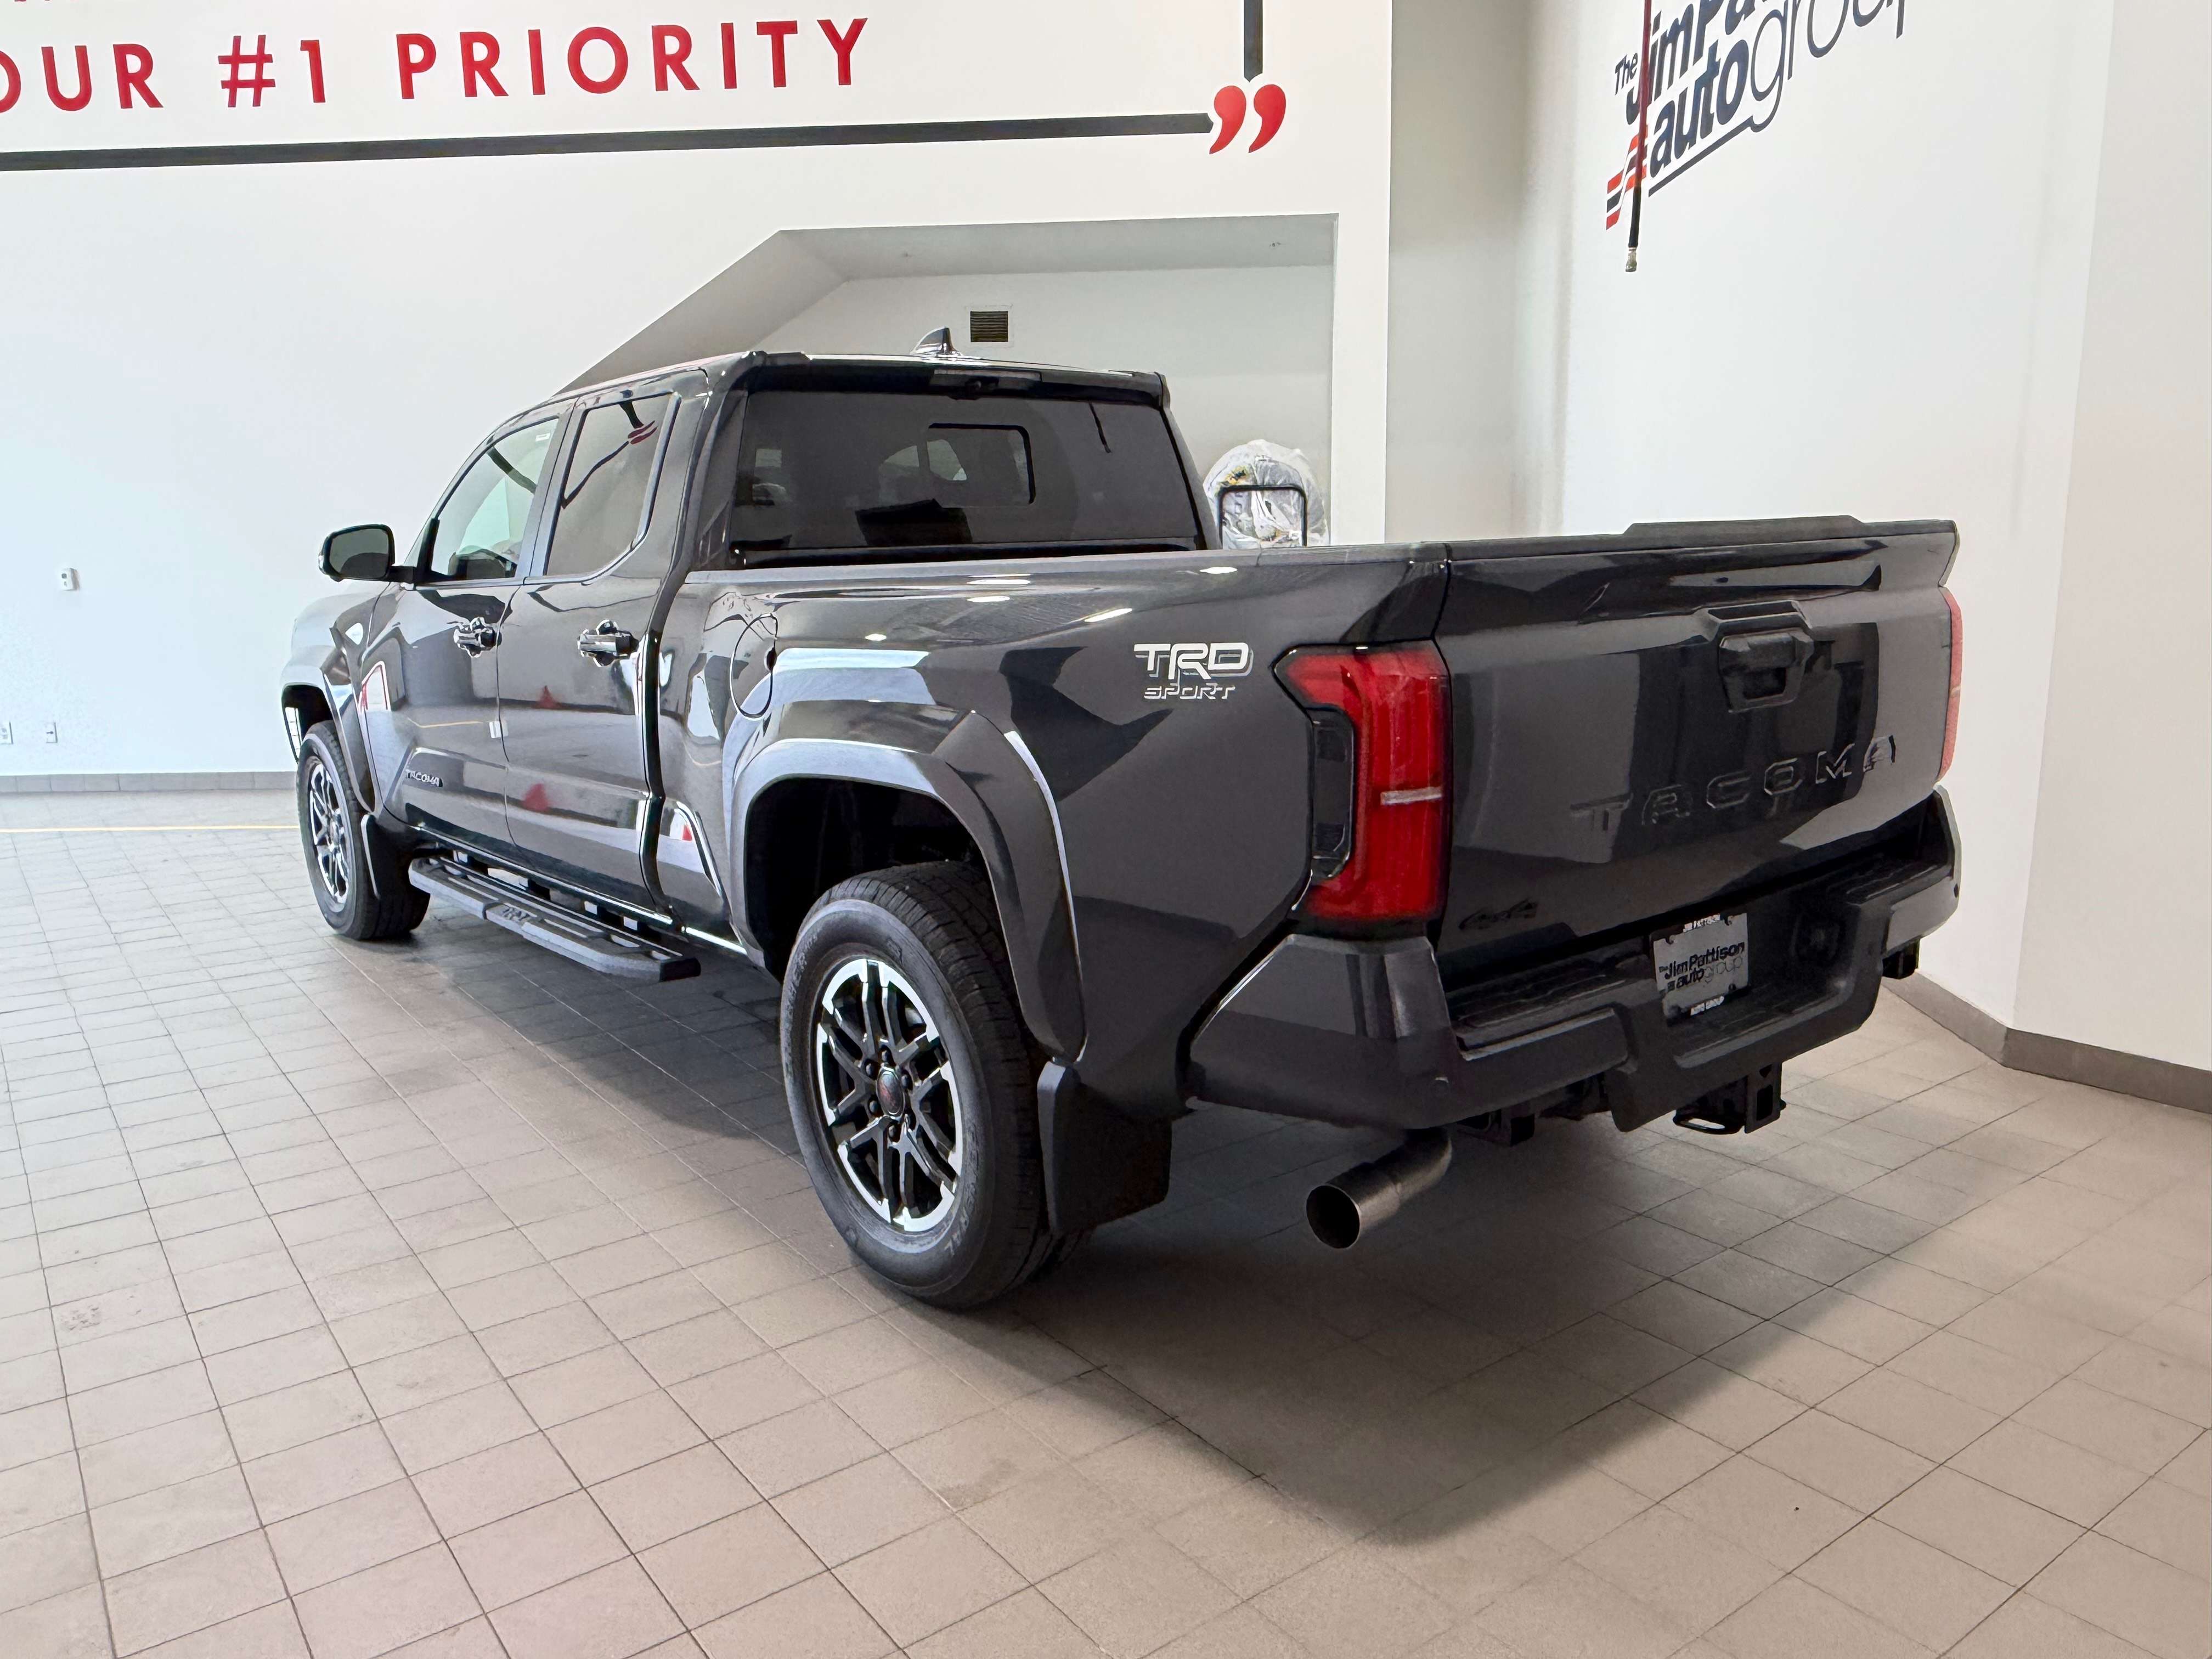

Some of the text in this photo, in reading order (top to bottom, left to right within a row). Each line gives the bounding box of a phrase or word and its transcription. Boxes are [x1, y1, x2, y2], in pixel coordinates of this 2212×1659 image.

[218, 35, 326, 108] #1
[396, 17, 868, 100] PRIORITY
[1615, 52, 1638, 95] The
[1133, 642, 1253, 680] TRD
[1144, 685, 1235, 699] SPORT
[405, 769, 443, 787] TACOMA
[1569, 735, 1896, 831] TACOMA
[1664, 942, 1745, 979] JimPattison
